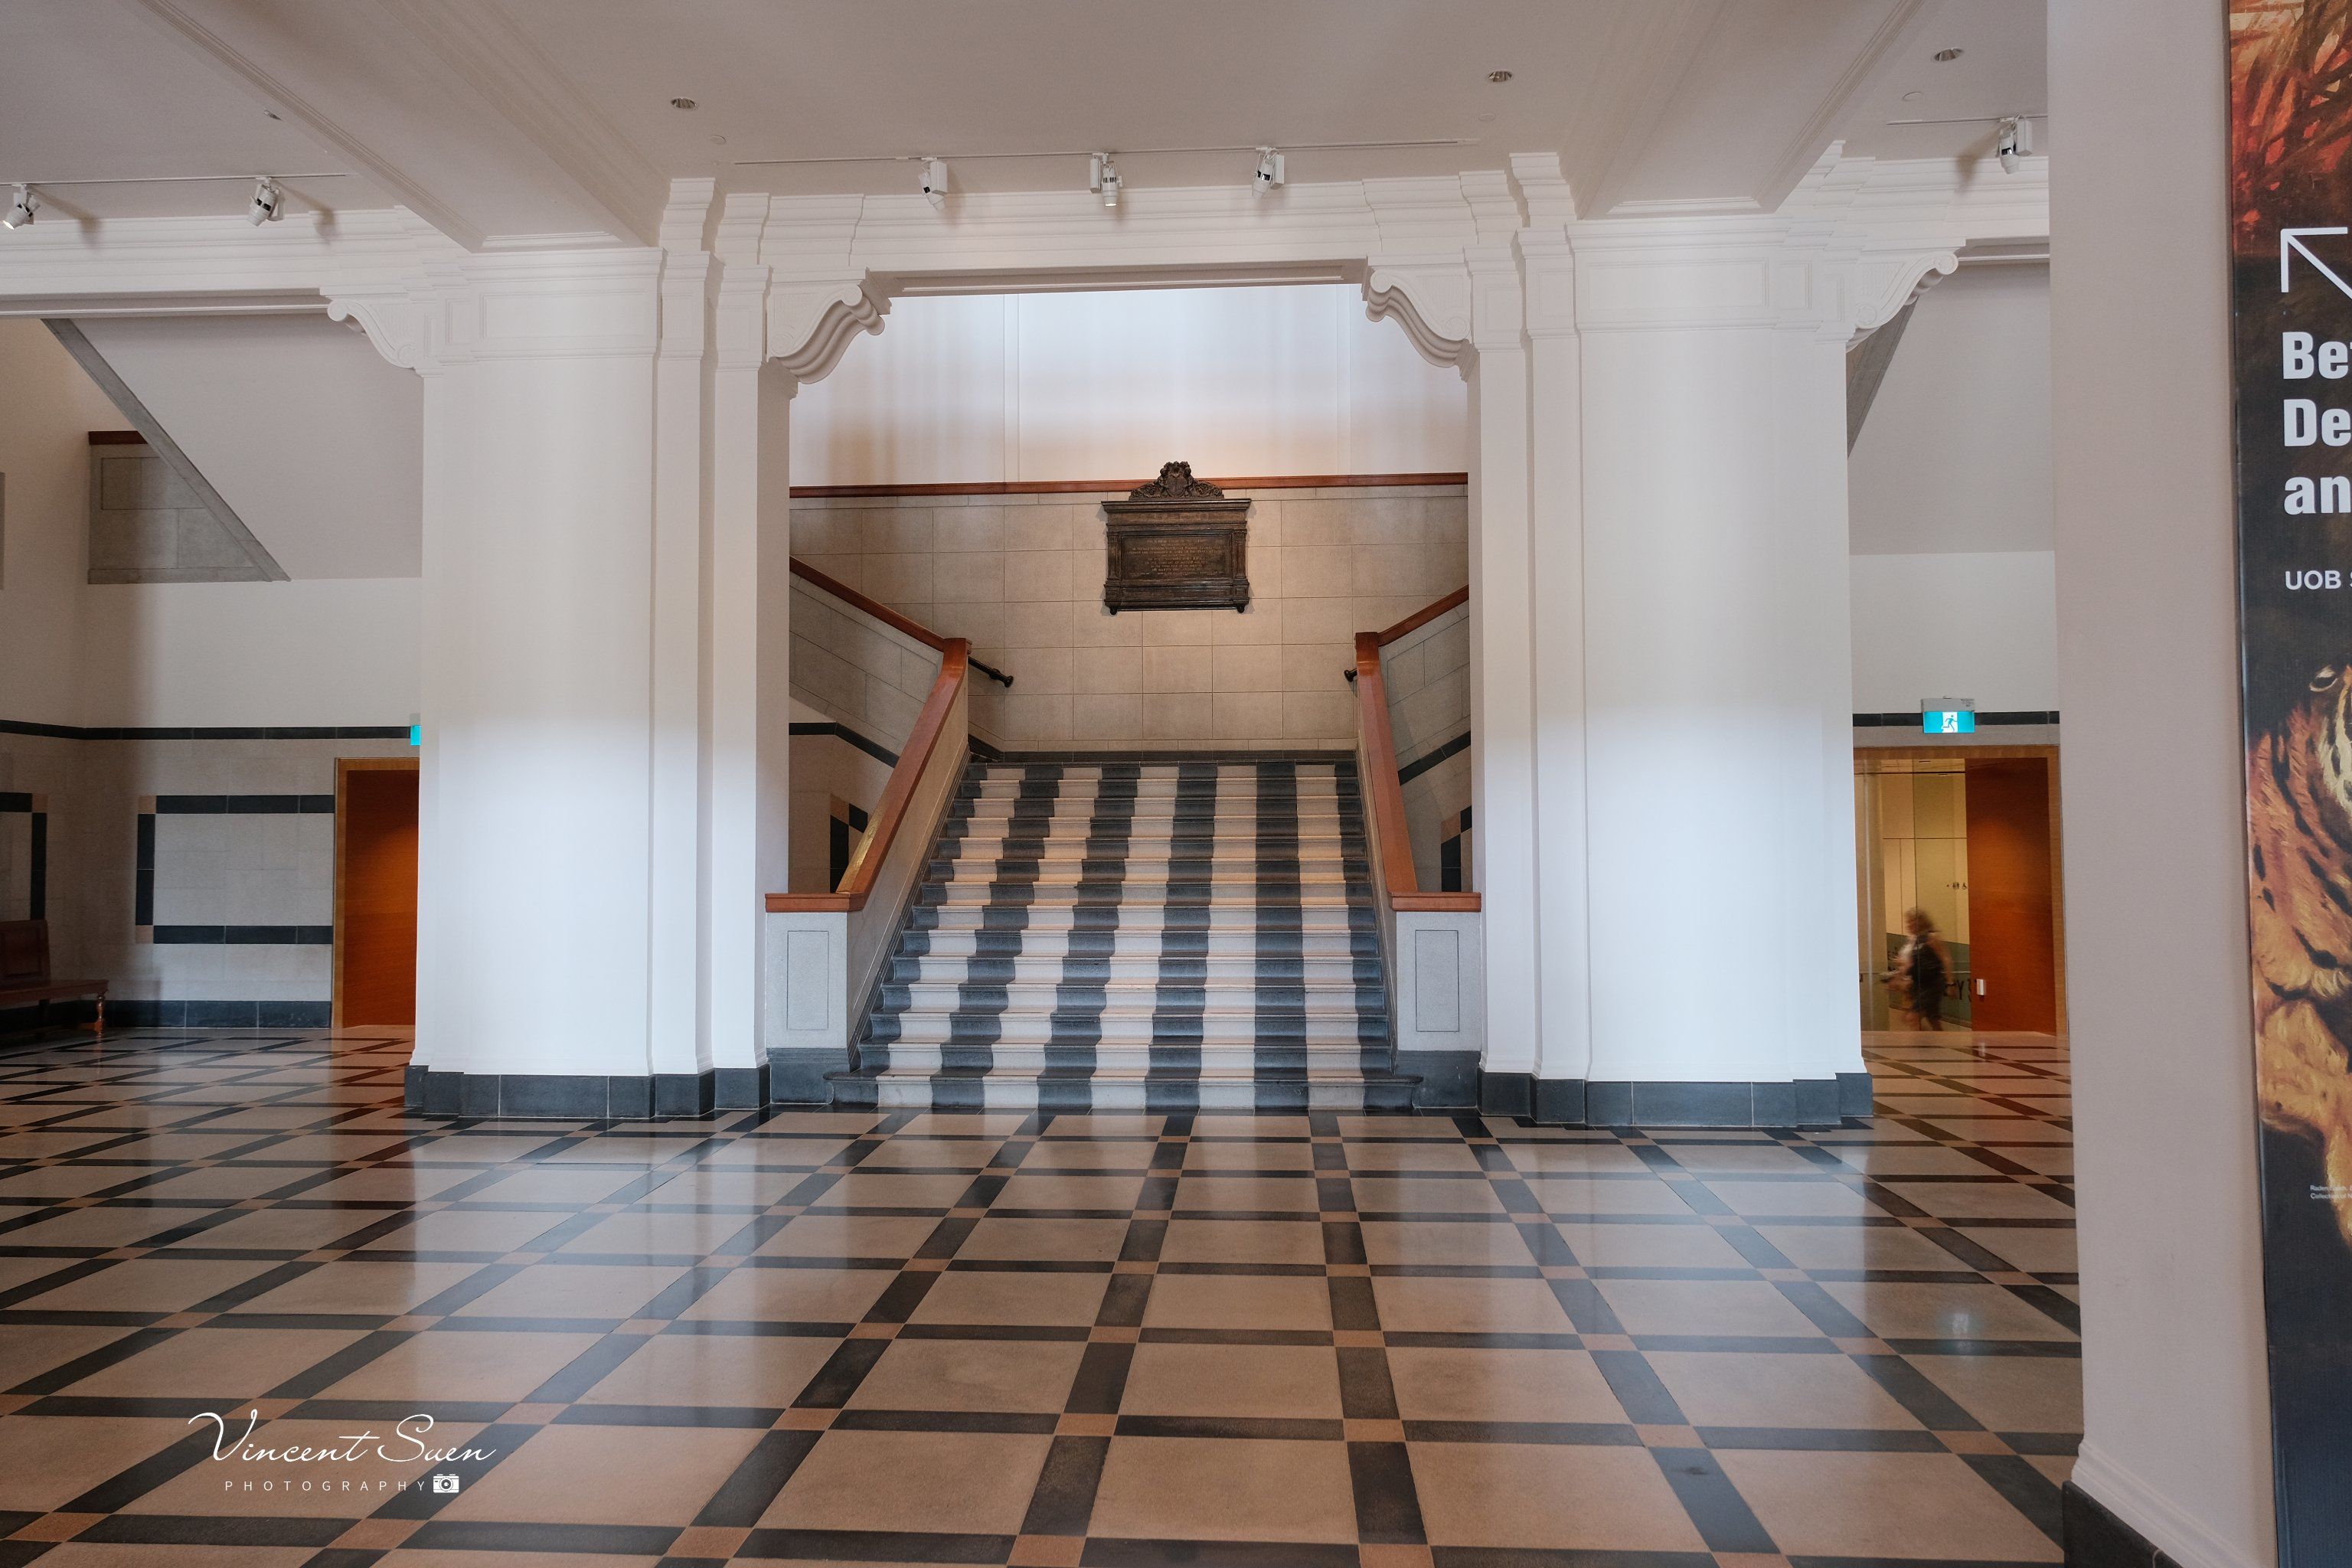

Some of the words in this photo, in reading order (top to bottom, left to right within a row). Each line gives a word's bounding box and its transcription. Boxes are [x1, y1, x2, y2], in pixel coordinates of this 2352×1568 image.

[2282, 332, 2352, 379] Be
[2283, 398, 2352, 446] De
[2284, 475, 2351, 515] an
[2285, 570, 2342, 590] UOB
